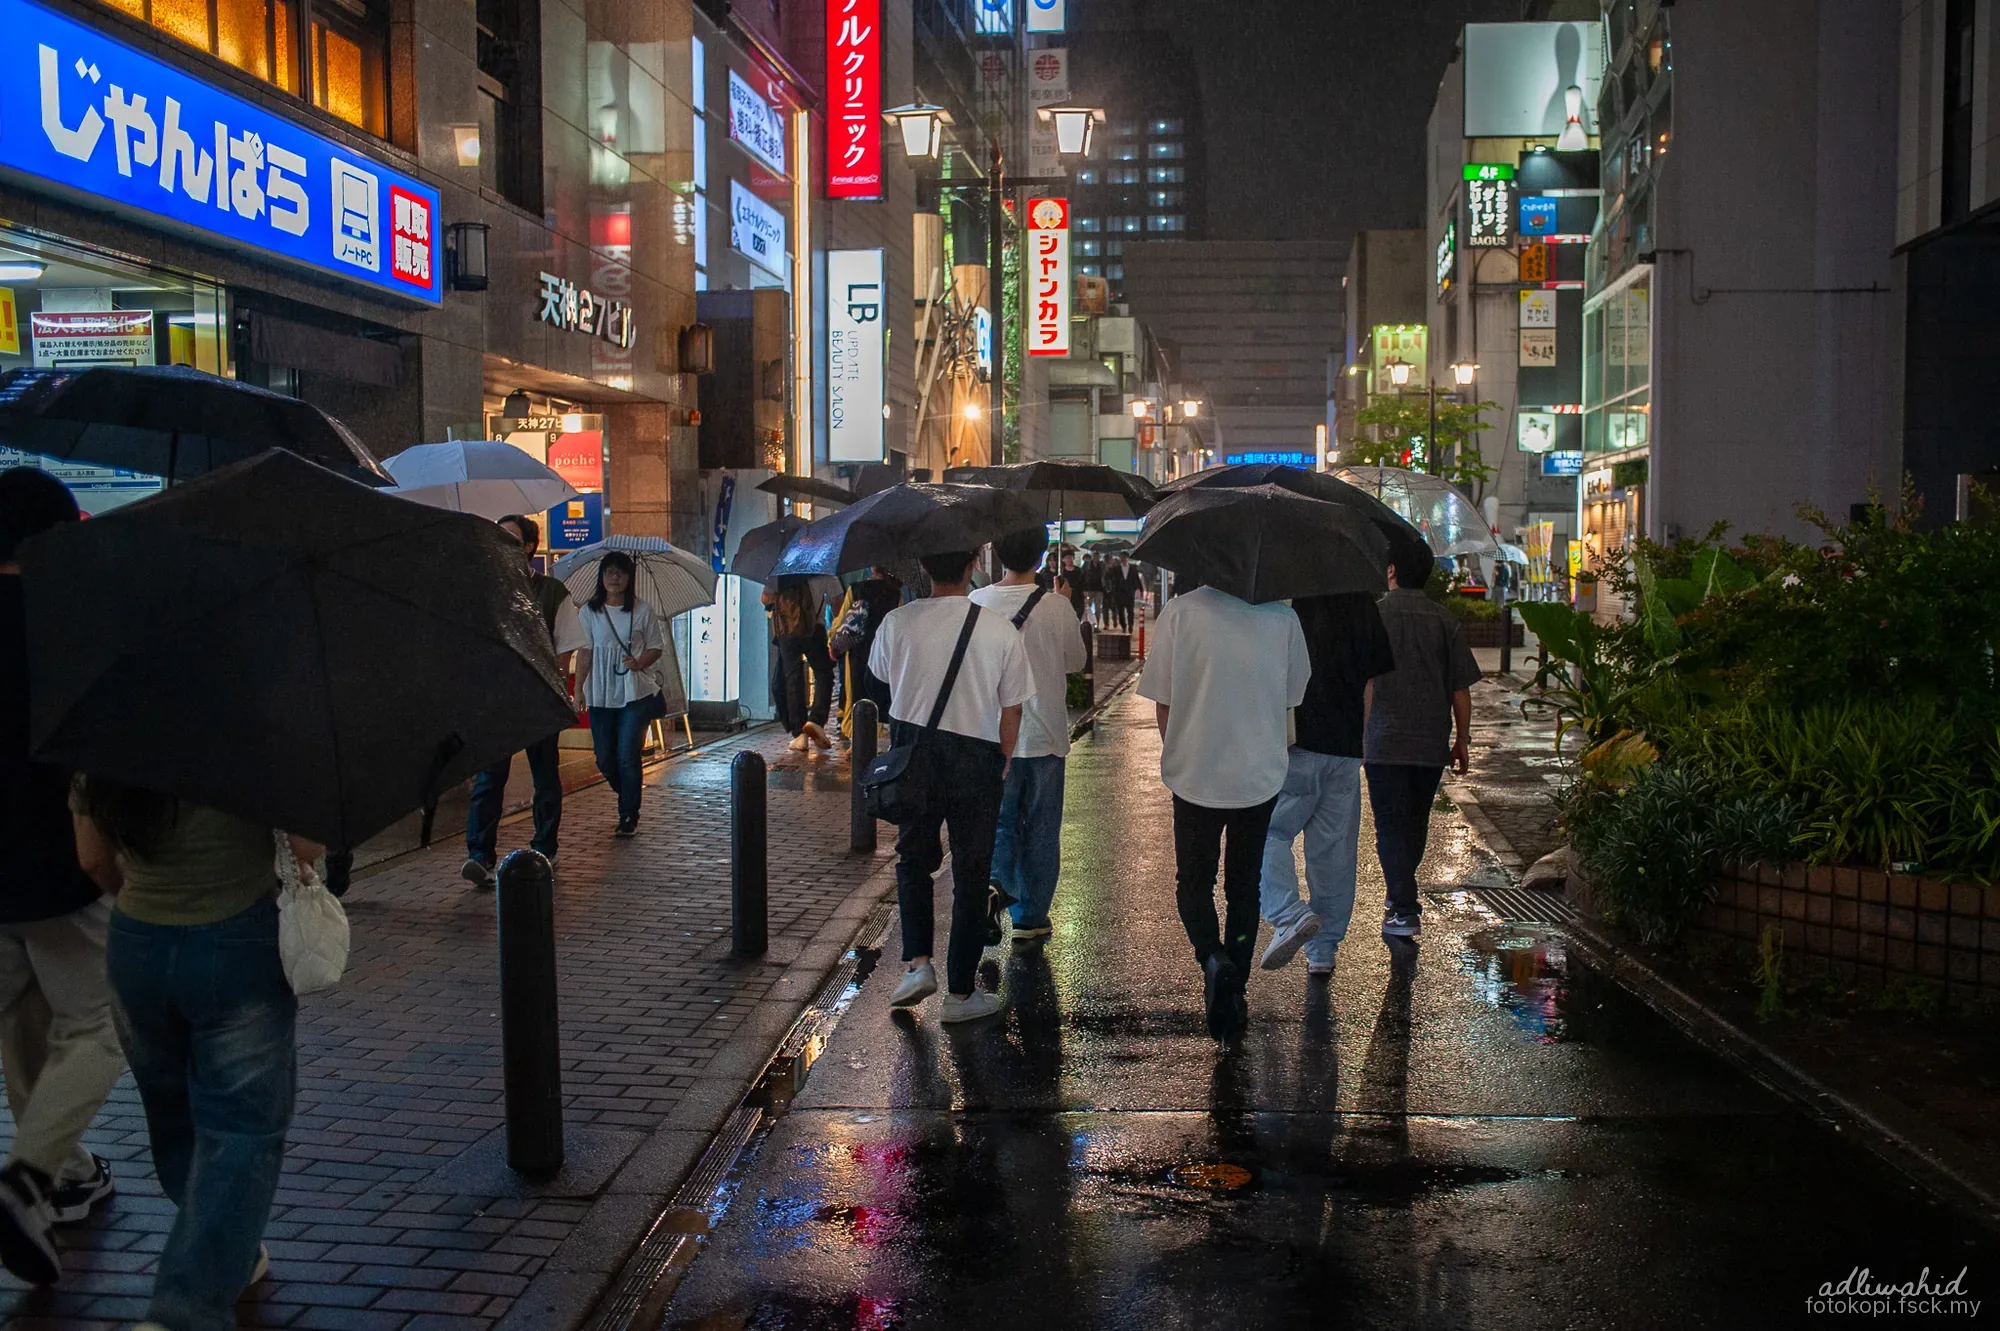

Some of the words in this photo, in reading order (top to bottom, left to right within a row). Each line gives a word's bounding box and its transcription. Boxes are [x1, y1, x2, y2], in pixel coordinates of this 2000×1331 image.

[38, 42, 310, 238] じゃんぱら
[1479, 165, 1499, 179] 4F
[394, 193, 429, 241] 買取
[1469, 180, 1484, 237] ビリヤード
[1482, 187, 1497, 226] ダーツ
[341, 243, 373, 266] ノートPC
[394, 234, 430, 280] 販売
[1469, 235, 1508, 246] BAGUS
[539, 270, 638, 350] 天神27ビル
[846, 283, 880, 325] LB
[1038, 234, 1060, 346] ジャンカラ
[37, 315, 150, 335] 法人買取強化中
[831, 330, 844, 381] BEAUTY
[847, 330, 859, 382] UPDATE
[517, 417, 563, 430] 天神27ビ
[831, 385, 844, 430] SALON
[549, 432, 557, 443] 9
[1244, 452, 1303, 464] 福岡(天神)駅
[555, 454, 596, 468] poche
